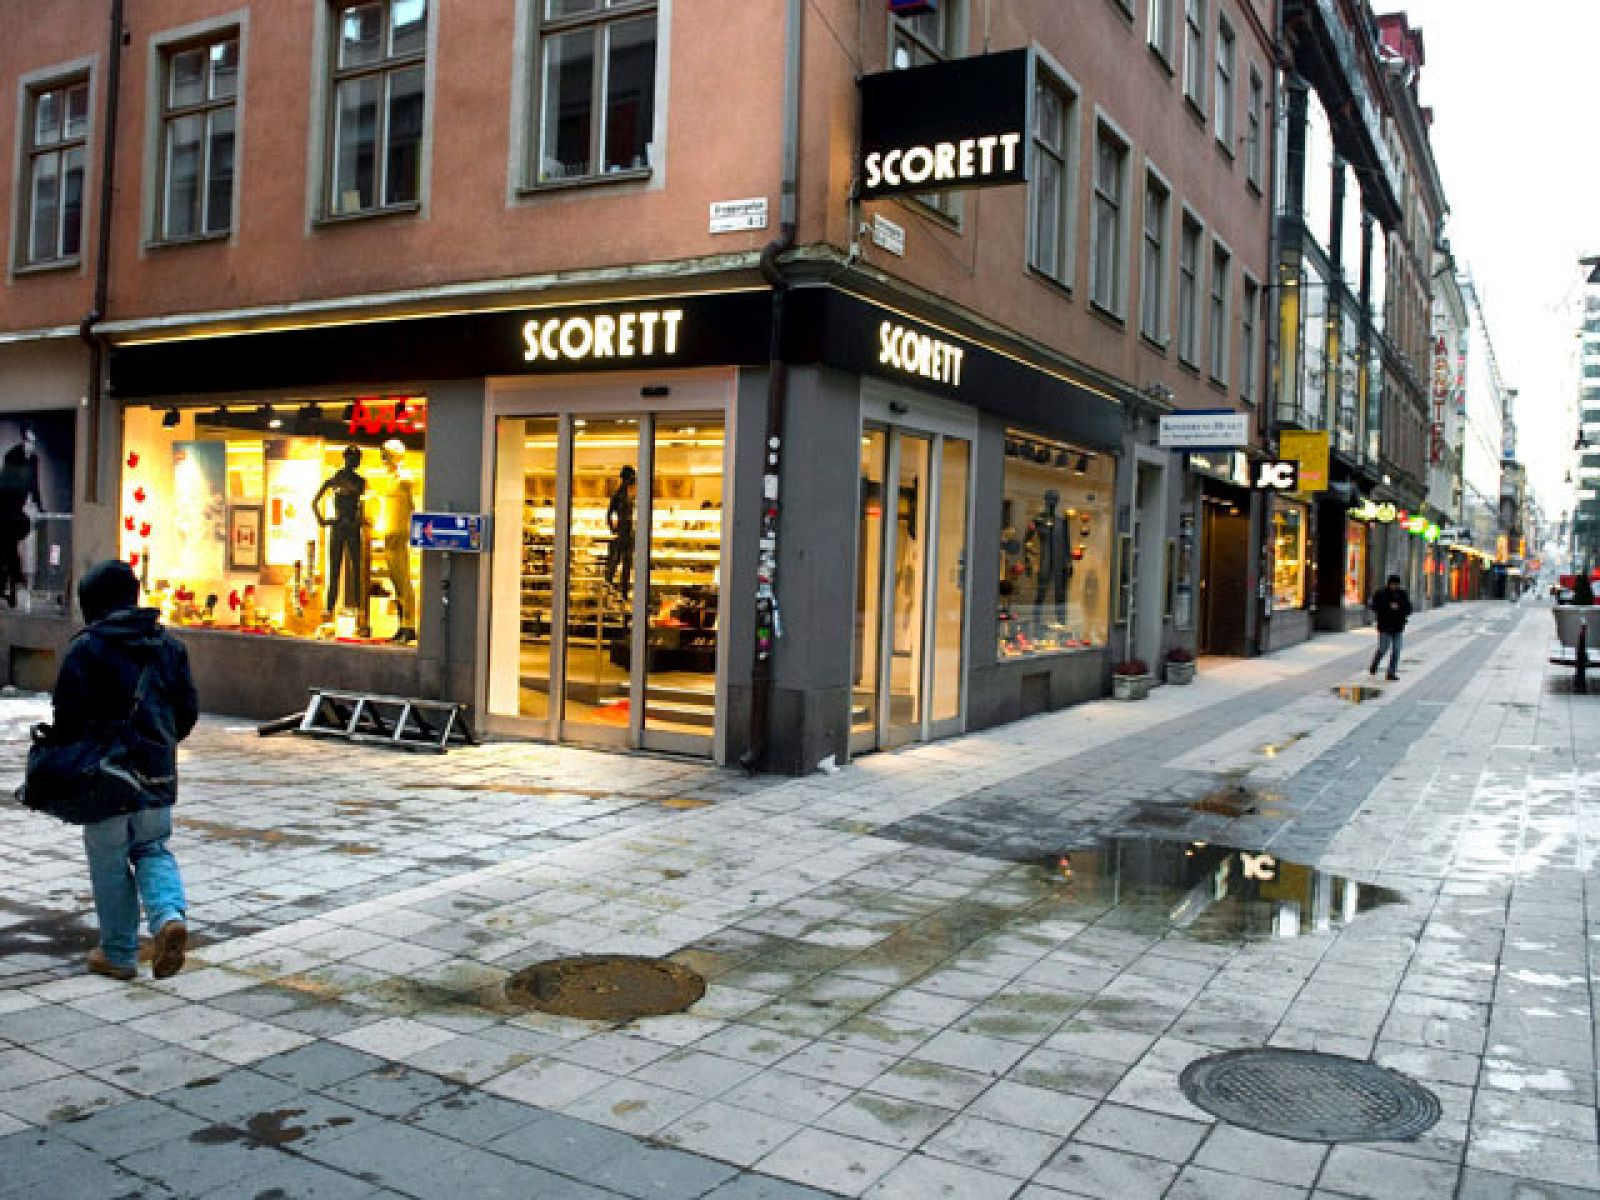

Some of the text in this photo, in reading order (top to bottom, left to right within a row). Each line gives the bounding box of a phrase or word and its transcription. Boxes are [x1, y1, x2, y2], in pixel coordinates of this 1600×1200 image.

[865, 132, 1021, 188] SCORETT
[522, 309, 684, 362] SCORETT
[879, 320, 964, 386] SCORETT
[1256, 461, 1294, 488] JC
